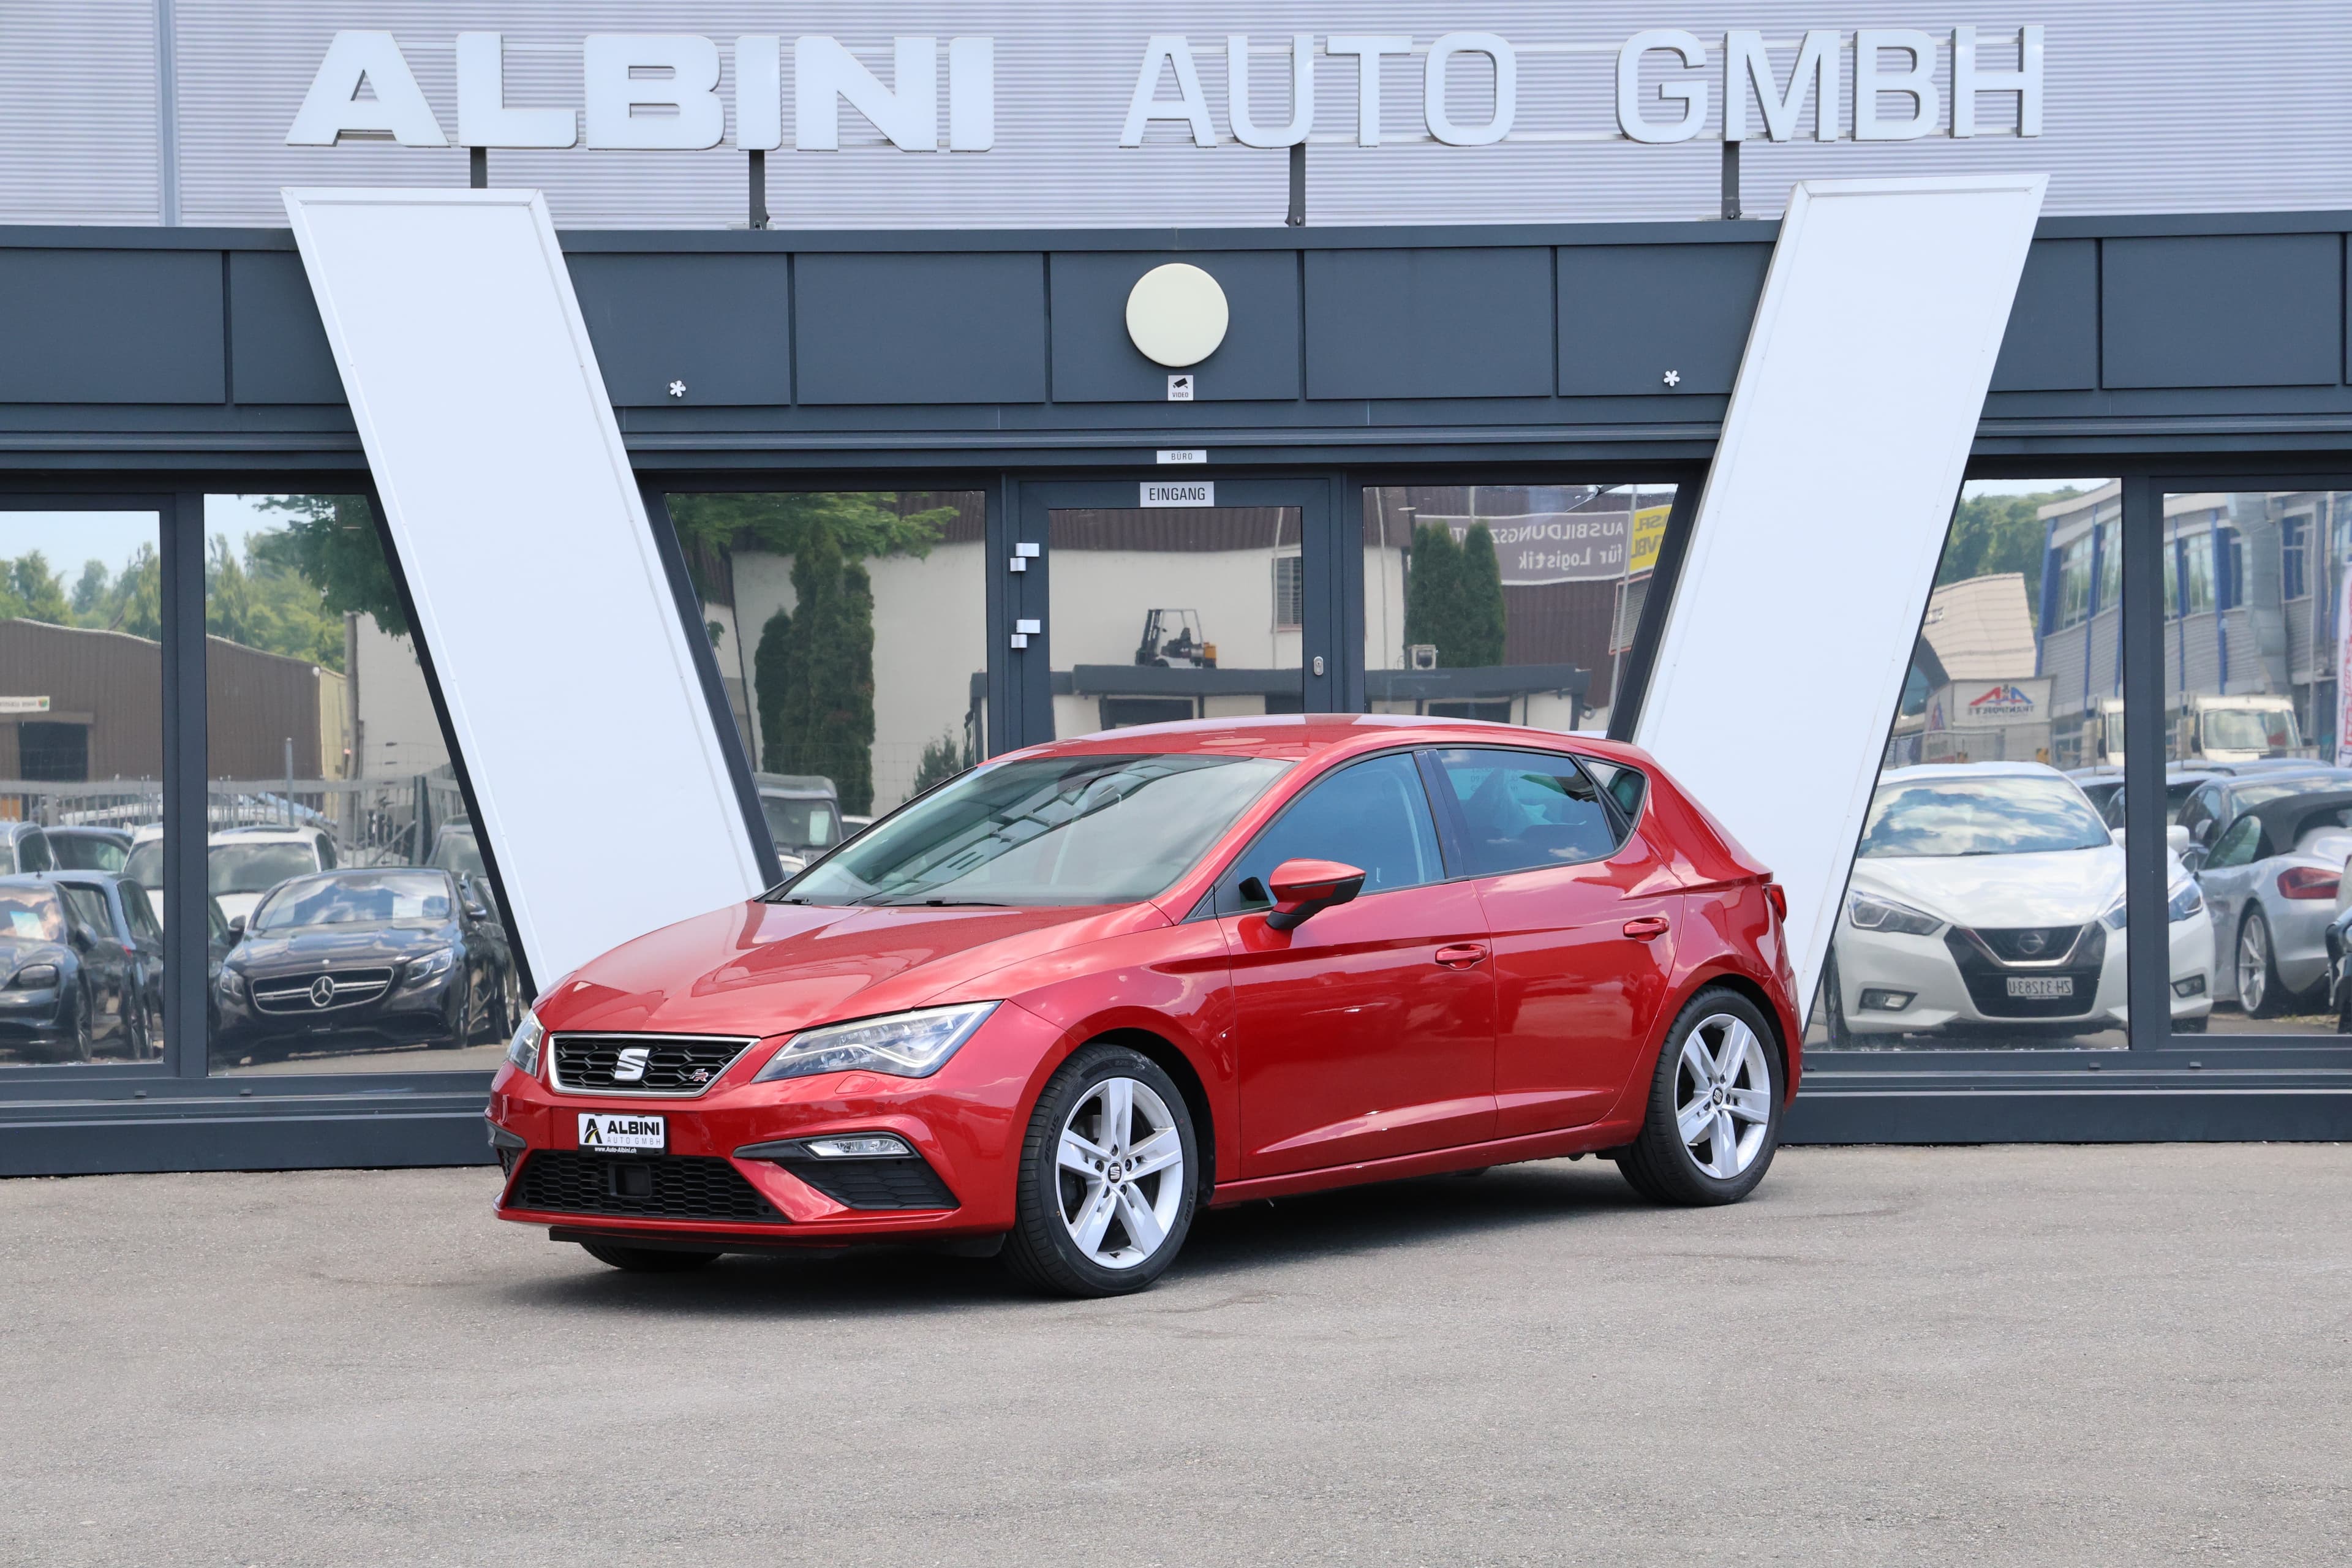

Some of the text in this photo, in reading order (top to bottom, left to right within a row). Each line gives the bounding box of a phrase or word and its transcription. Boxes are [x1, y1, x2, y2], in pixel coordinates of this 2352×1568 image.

[285, 24, 2045, 153] ALBINI AUTO GMBH
[1170, 451, 1193, 461] BÜRO
[1148, 487, 1206, 501] EINGANG
[607, 1120, 660, 1136] ALBINI
